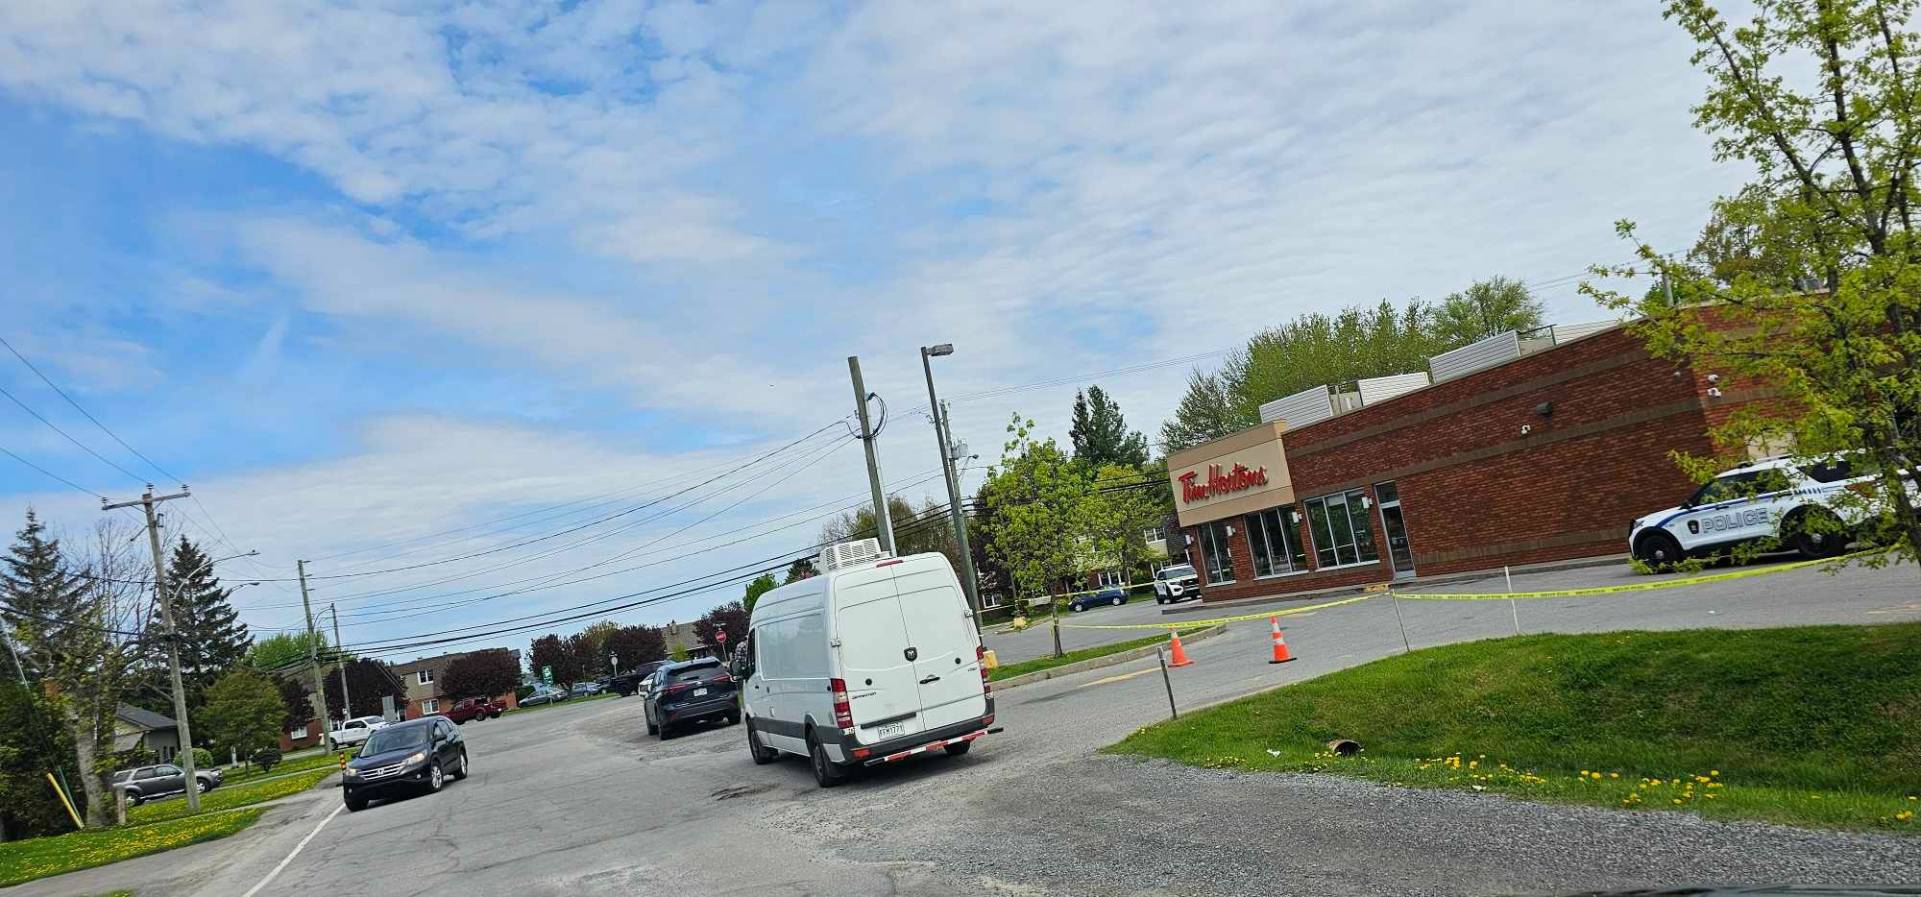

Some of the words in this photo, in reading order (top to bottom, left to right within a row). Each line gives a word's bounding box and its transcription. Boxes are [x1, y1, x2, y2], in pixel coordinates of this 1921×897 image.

[1178, 470, 1209, 505] Tim
[1208, 462, 1268, 496] Hortons
[1702, 507, 1769, 534] POLICE
